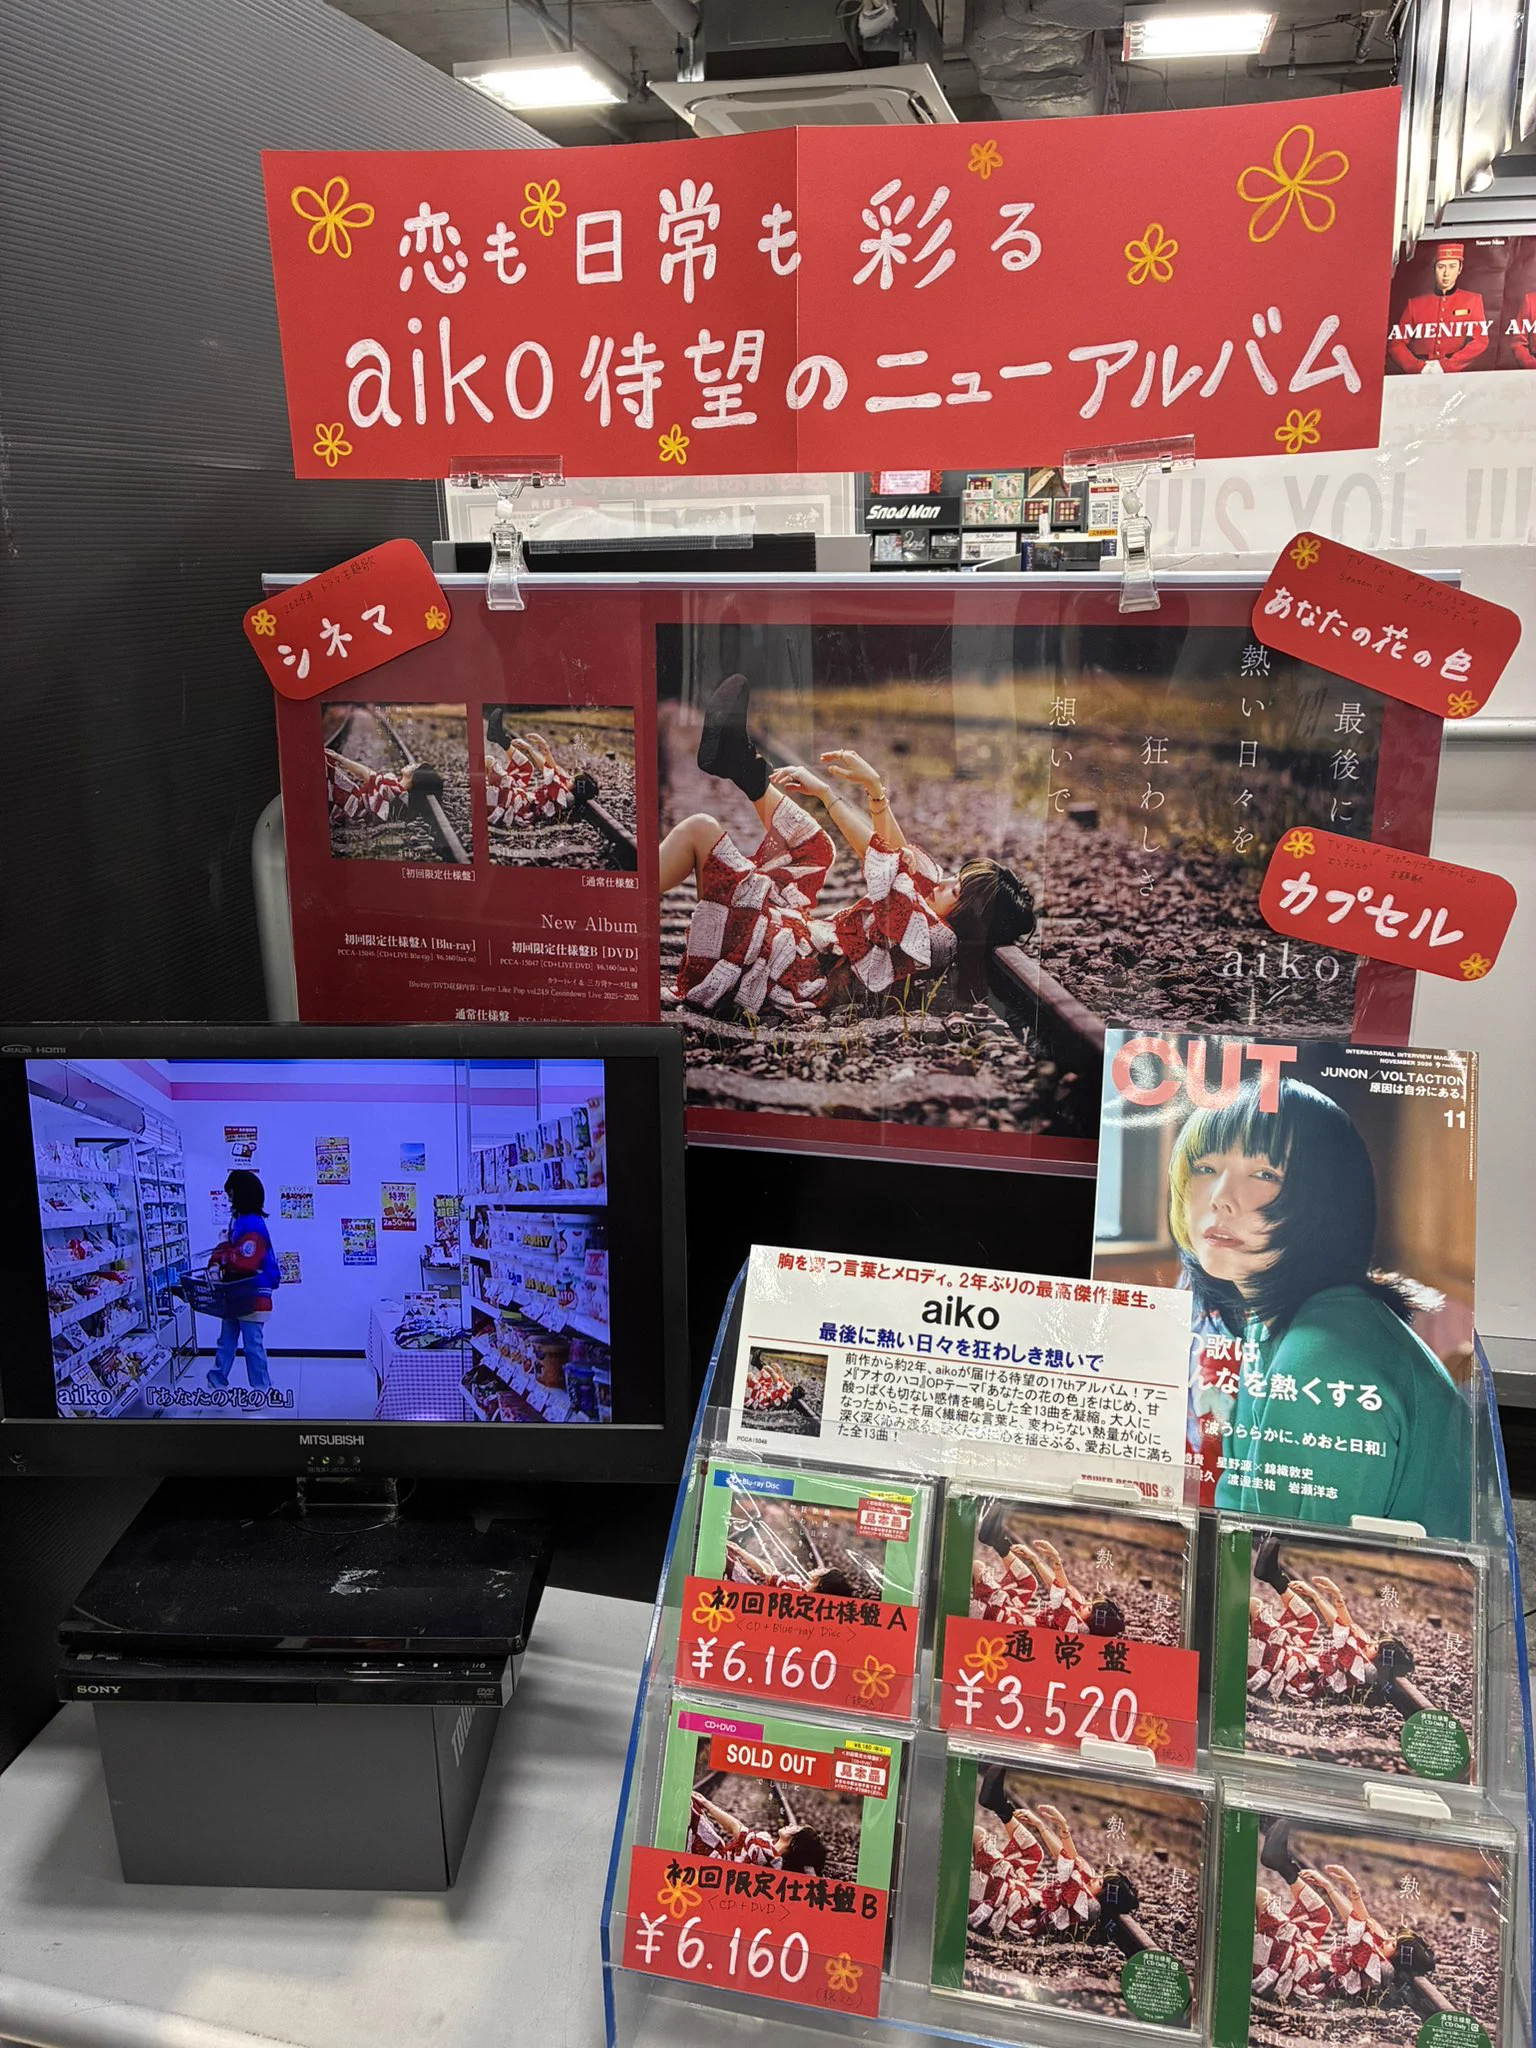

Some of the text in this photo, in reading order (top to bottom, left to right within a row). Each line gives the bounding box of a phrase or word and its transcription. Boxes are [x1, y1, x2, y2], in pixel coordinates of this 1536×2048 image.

[1388, 320, 1493, 340] AMENITY
[277, 604, 393, 679] シネマ
[1264, 586, 1473, 683] あなたの花の色
[1048, 696, 1077, 814] 想いで
[1231, 644, 1272, 855] 熱い日々を
[1329, 701, 1367, 824] 最後に
[1139, 736, 1169, 898] 狂わしき
[541, 914, 638, 935] New Album
[1279, 871, 1465, 947] カプセル
[1222, 941, 1340, 982] aiko
[1345, 1049, 1396, 1058] INTERNATIONAL
[1397, 1052, 1432, 1060] INTERVIEW
[1379, 1058, 1416, 1066] NOVEMBER
[1111, 1036, 1298, 1114] CUT
[1443, 1110, 1466, 1129] 11
[921, 1295, 1000, 1331] aiko
[818, 1322, 1105, 1372] 最後に熱い日々を狂わしき想いで
[57, 1384, 112, 1406] aiko
[299, 1434, 365, 1446] MITSUBISHI
[765, 1481, 780, 1490] Disc
[1003, 1629, 1132, 1675] 通常盤
[76, 1684, 122, 1694] SONY
[704, 1720, 737, 1734] CD+DVD
[726, 1743, 817, 1776] SOLD OUT
